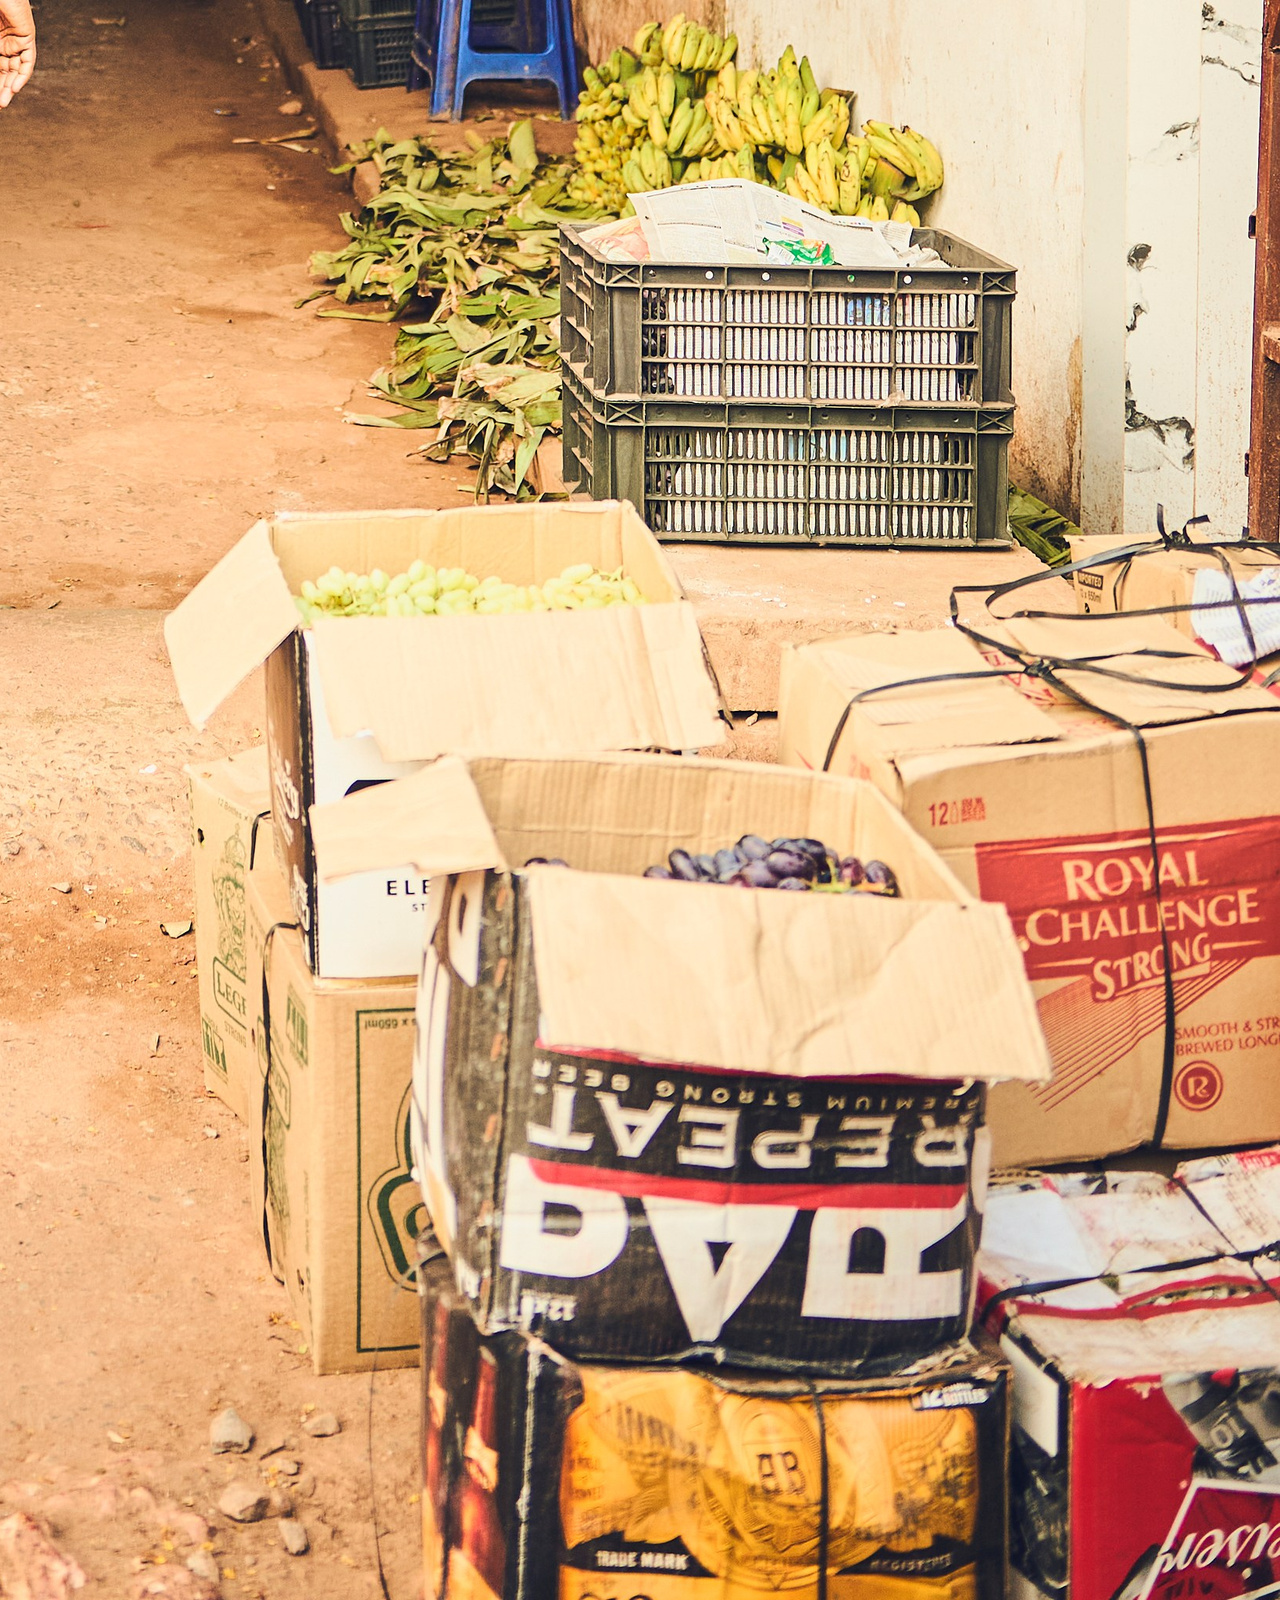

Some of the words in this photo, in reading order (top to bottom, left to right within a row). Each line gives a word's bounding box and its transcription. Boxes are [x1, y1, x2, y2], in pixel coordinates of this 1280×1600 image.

[928, 802, 949, 827] 12
[1061, 850, 1210, 902] ROYAL
[1025, 887, 1261, 947] CHALLENGE
[1093, 931, 1211, 1000] STRONG
[1174, 1022, 1238, 1041] SMOOTH
[1242, 1020, 1252, 1033] &
[1176, 1038, 1234, 1056] BREWED
[1239, 1033, 1280, 1050] LONG
[531, 1059, 632, 1092] BEER
[656, 1080, 802, 1109] STRONG
[525, 1083, 974, 1170] REPEAT
[595, 1550, 638, 1568] TRADE
[641, 1551, 690, 1571] MARK
